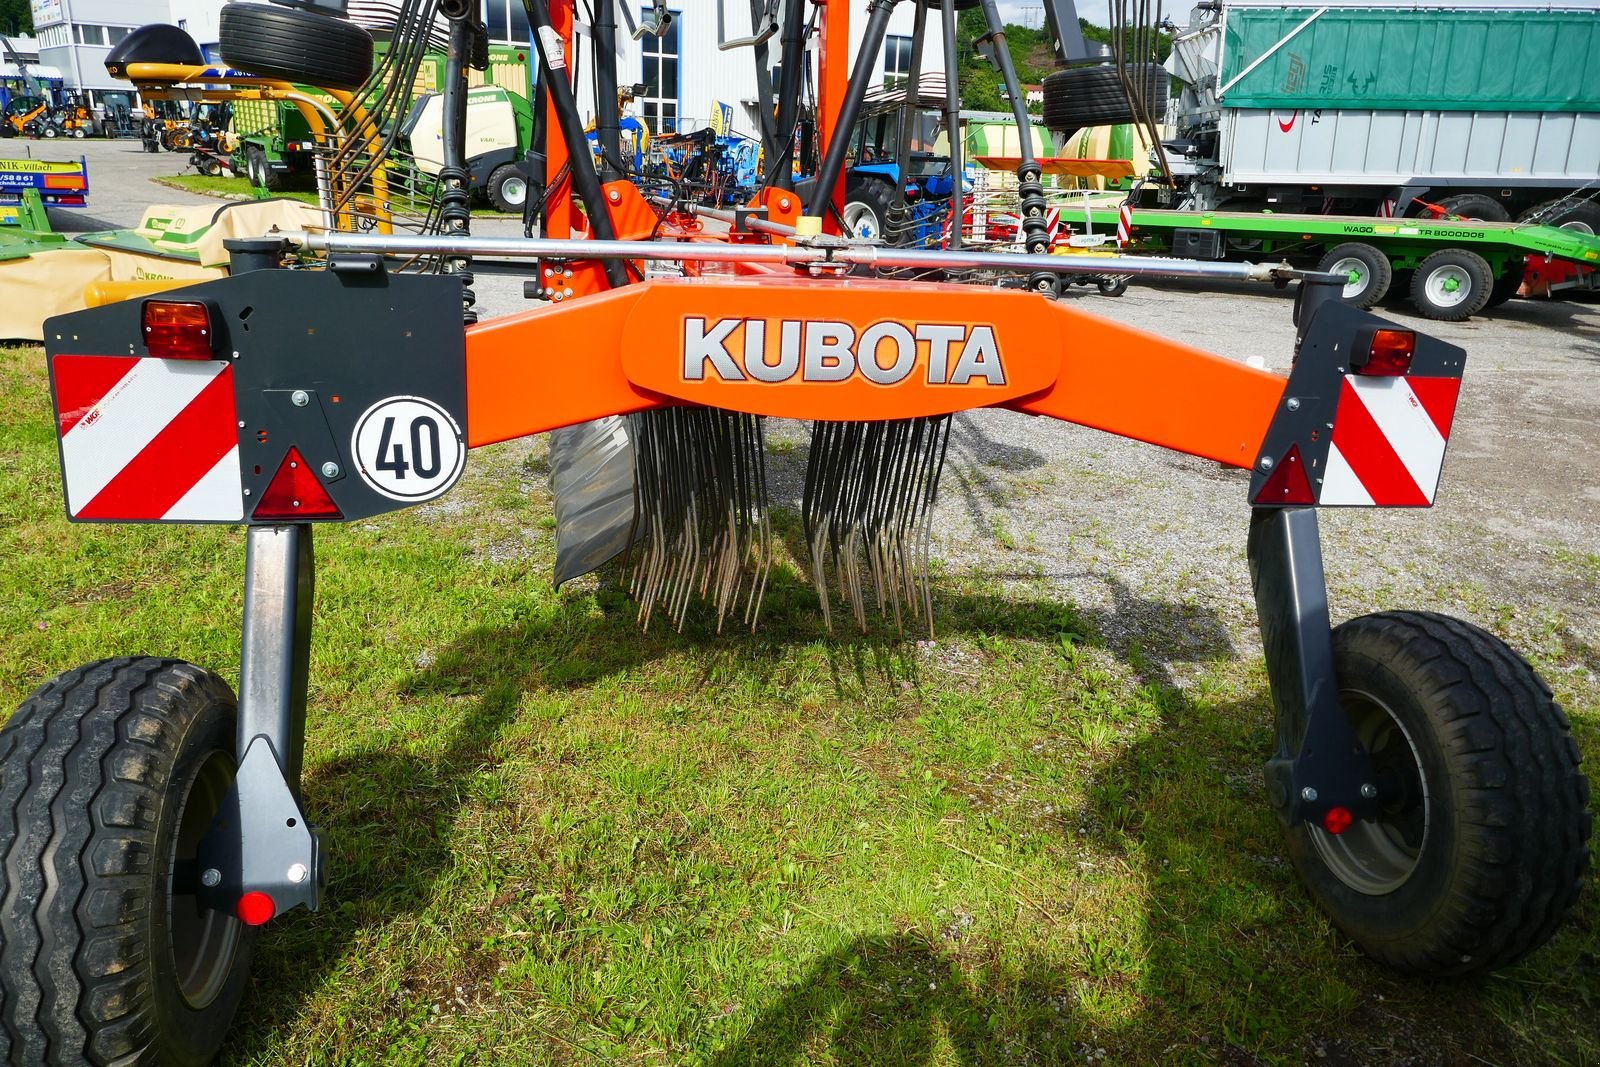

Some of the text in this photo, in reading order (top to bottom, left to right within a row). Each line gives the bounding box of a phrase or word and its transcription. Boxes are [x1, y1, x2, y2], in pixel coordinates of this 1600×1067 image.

[1343, 225, 1373, 234] WAGO
[682, 316, 1008, 387] KUBOTA
[375, 415, 442, 480] 40
